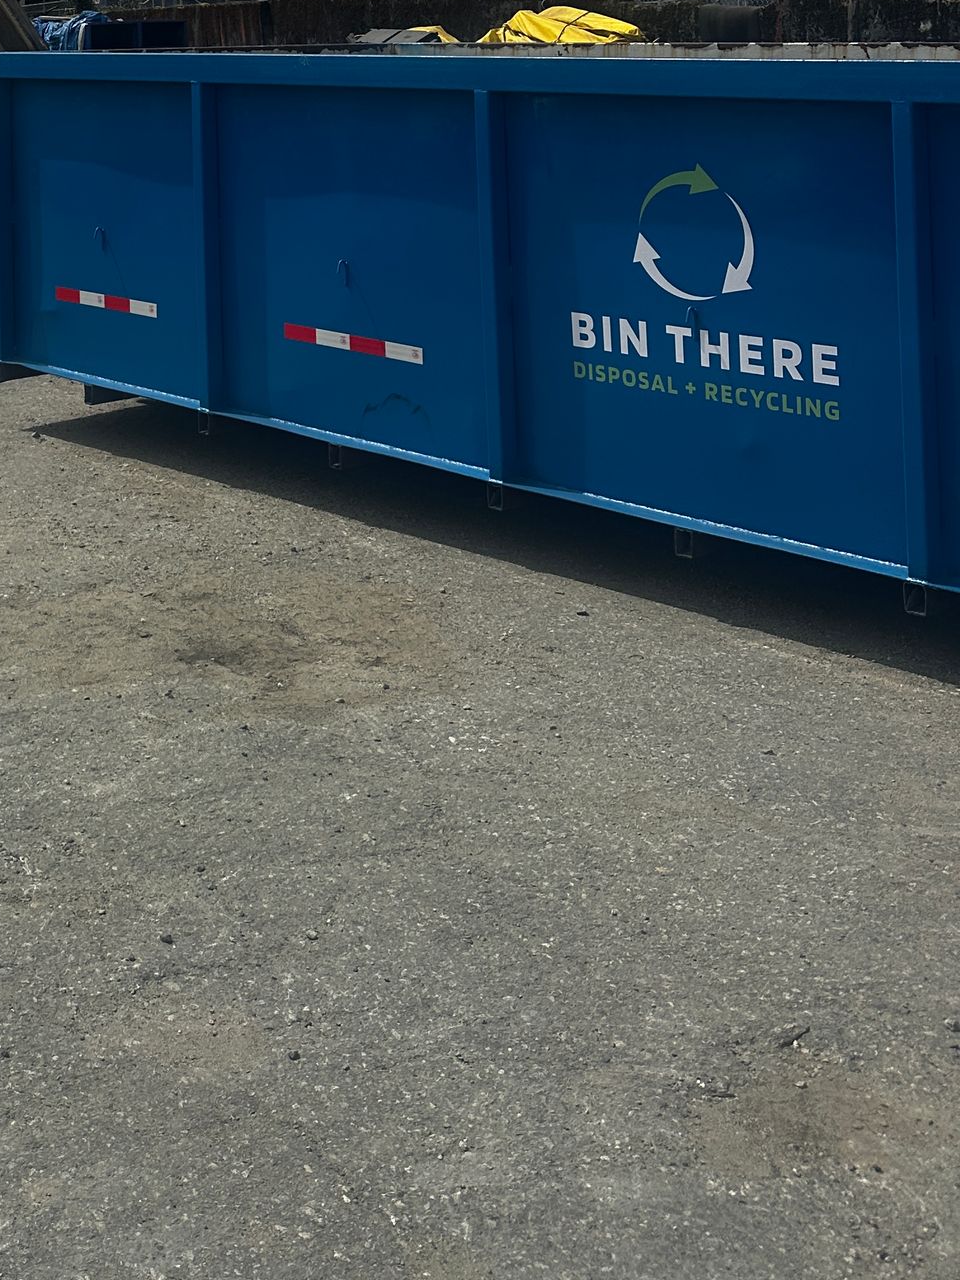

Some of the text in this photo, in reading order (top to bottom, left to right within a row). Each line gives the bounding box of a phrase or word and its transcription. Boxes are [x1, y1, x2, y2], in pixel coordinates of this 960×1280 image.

[571, 311, 840, 387] BIN THERE
[573, 361, 840, 421] DISPOSAL + RECYCLING
